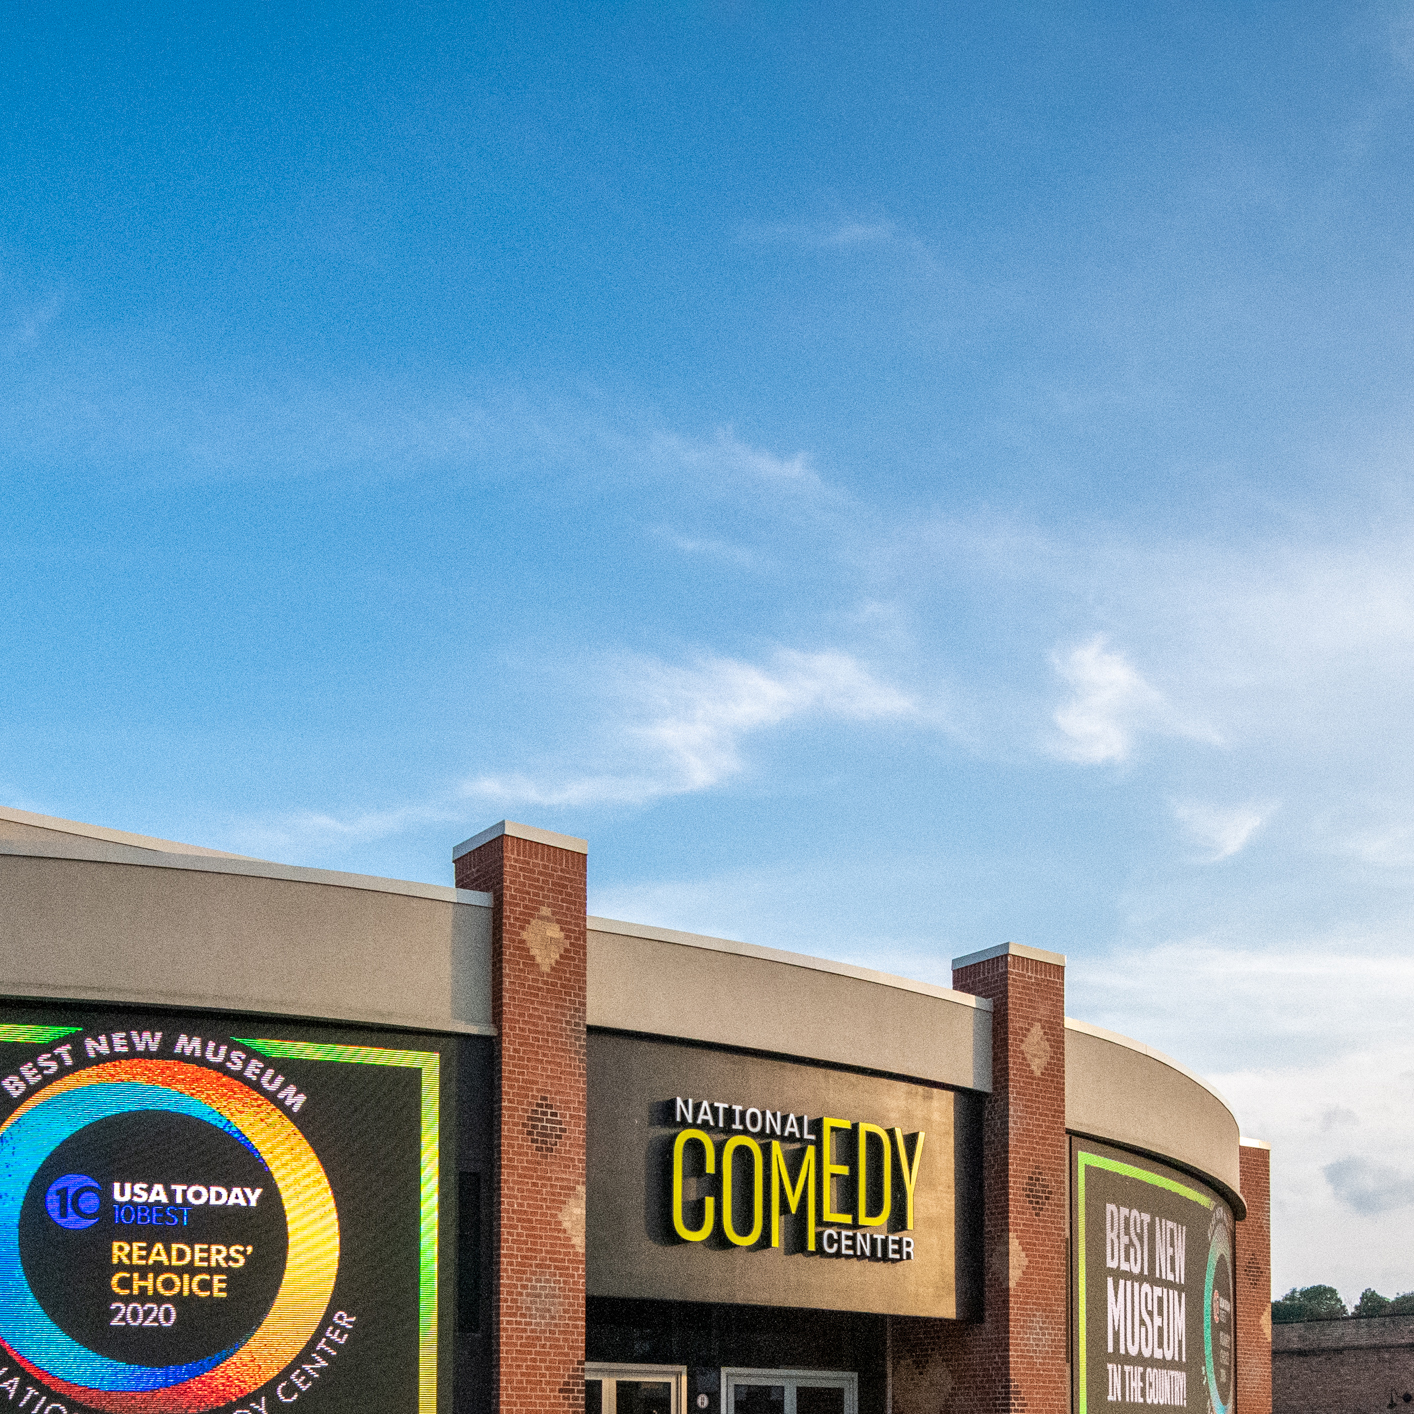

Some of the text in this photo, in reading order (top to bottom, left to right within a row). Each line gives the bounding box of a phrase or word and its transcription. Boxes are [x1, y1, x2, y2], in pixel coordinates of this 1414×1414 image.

[1, 1030, 307, 1113] BEST NEW MUSEUM
[675, 1096, 816, 1140] NATIONAL
[112, 1182, 264, 1207] USA TODAY
[672, 1117, 926, 1252] COMEDY
[112, 1204, 193, 1226] 10BEST
[822, 1229, 915, 1261] CENTER
[1105, 1203, 1151, 1277] BEST
[1155, 1216, 1187, 1285] NEW
[110, 1271, 229, 1298] CHOICE
[109, 1302, 177, 1327] 2020
[1106, 1276, 1187, 1362] MUSEUM
[276, 1310, 356, 1403] CENTER
[1106, 1363, 1187, 1407] IN THE COUNTRY!
